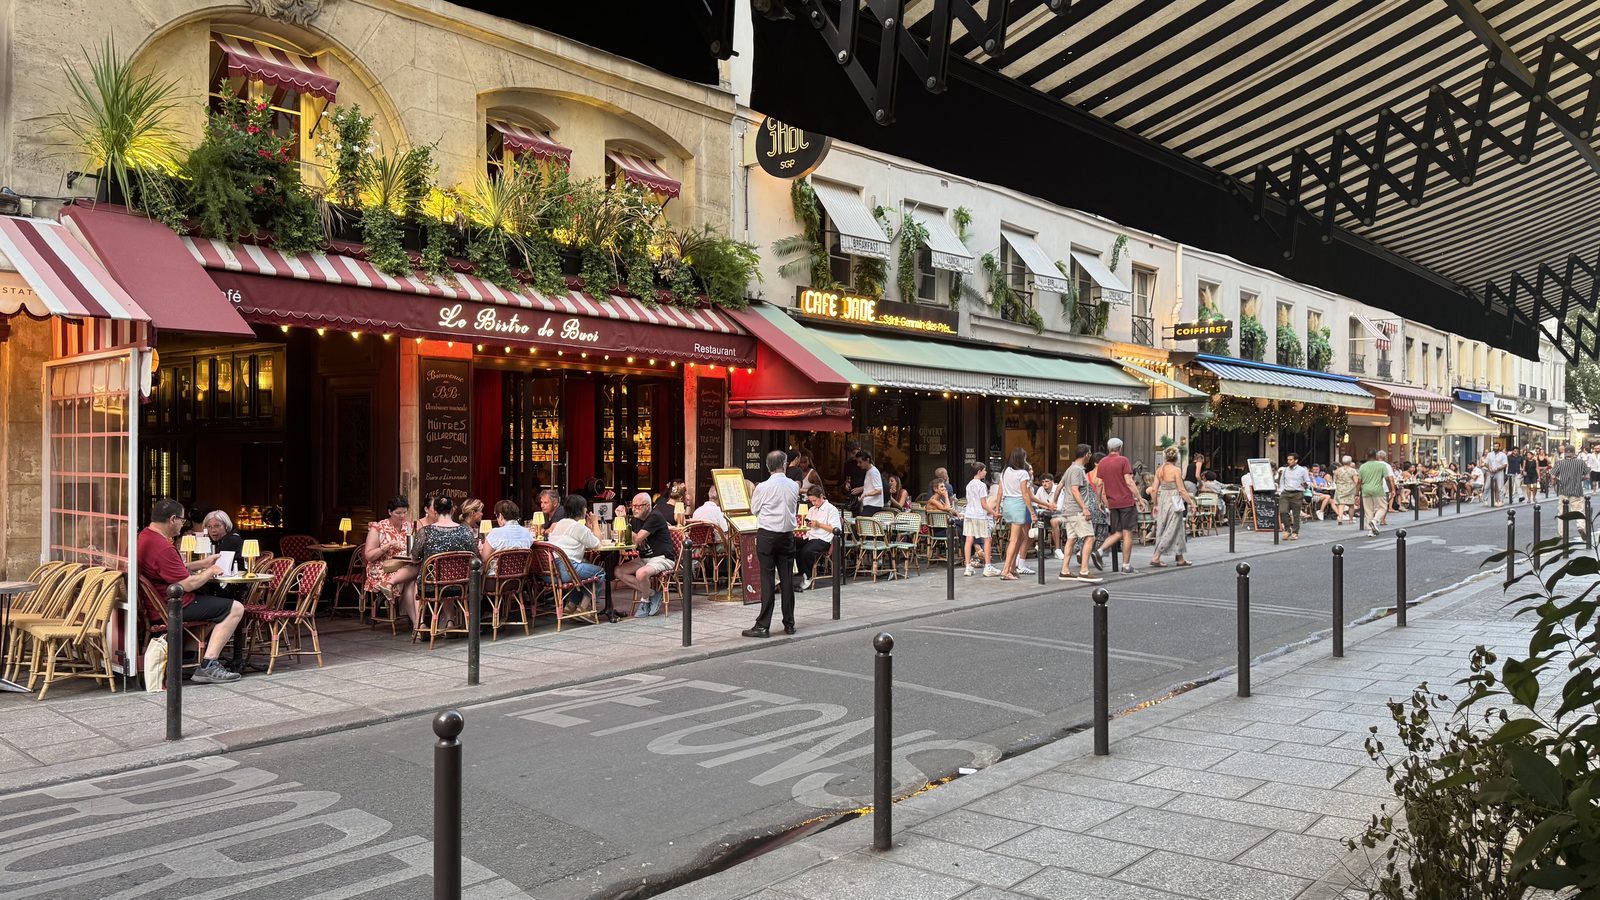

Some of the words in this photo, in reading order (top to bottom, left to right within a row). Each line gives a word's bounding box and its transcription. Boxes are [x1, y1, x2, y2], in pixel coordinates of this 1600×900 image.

[780, 159, 796, 170] SGP
[852, 239, 879, 253] BREAKFAST
[2, 286, 38, 297] STAT
[800, 289, 838, 318] CAFE
[840, 296, 876, 323] JADE
[438, 303, 467, 329] Le
[473, 307, 530, 335] Bistro
[537, 317, 555, 338] de
[1176, 325, 1228, 336] COIFFIRST
[694, 342, 736, 357] Restaurant
[747, 439, 760, 447] FOOD
[426, 454, 443, 464] PLAT
[450, 455, 468, 464] JOUR
[745, 462, 760, 470] BURGER
